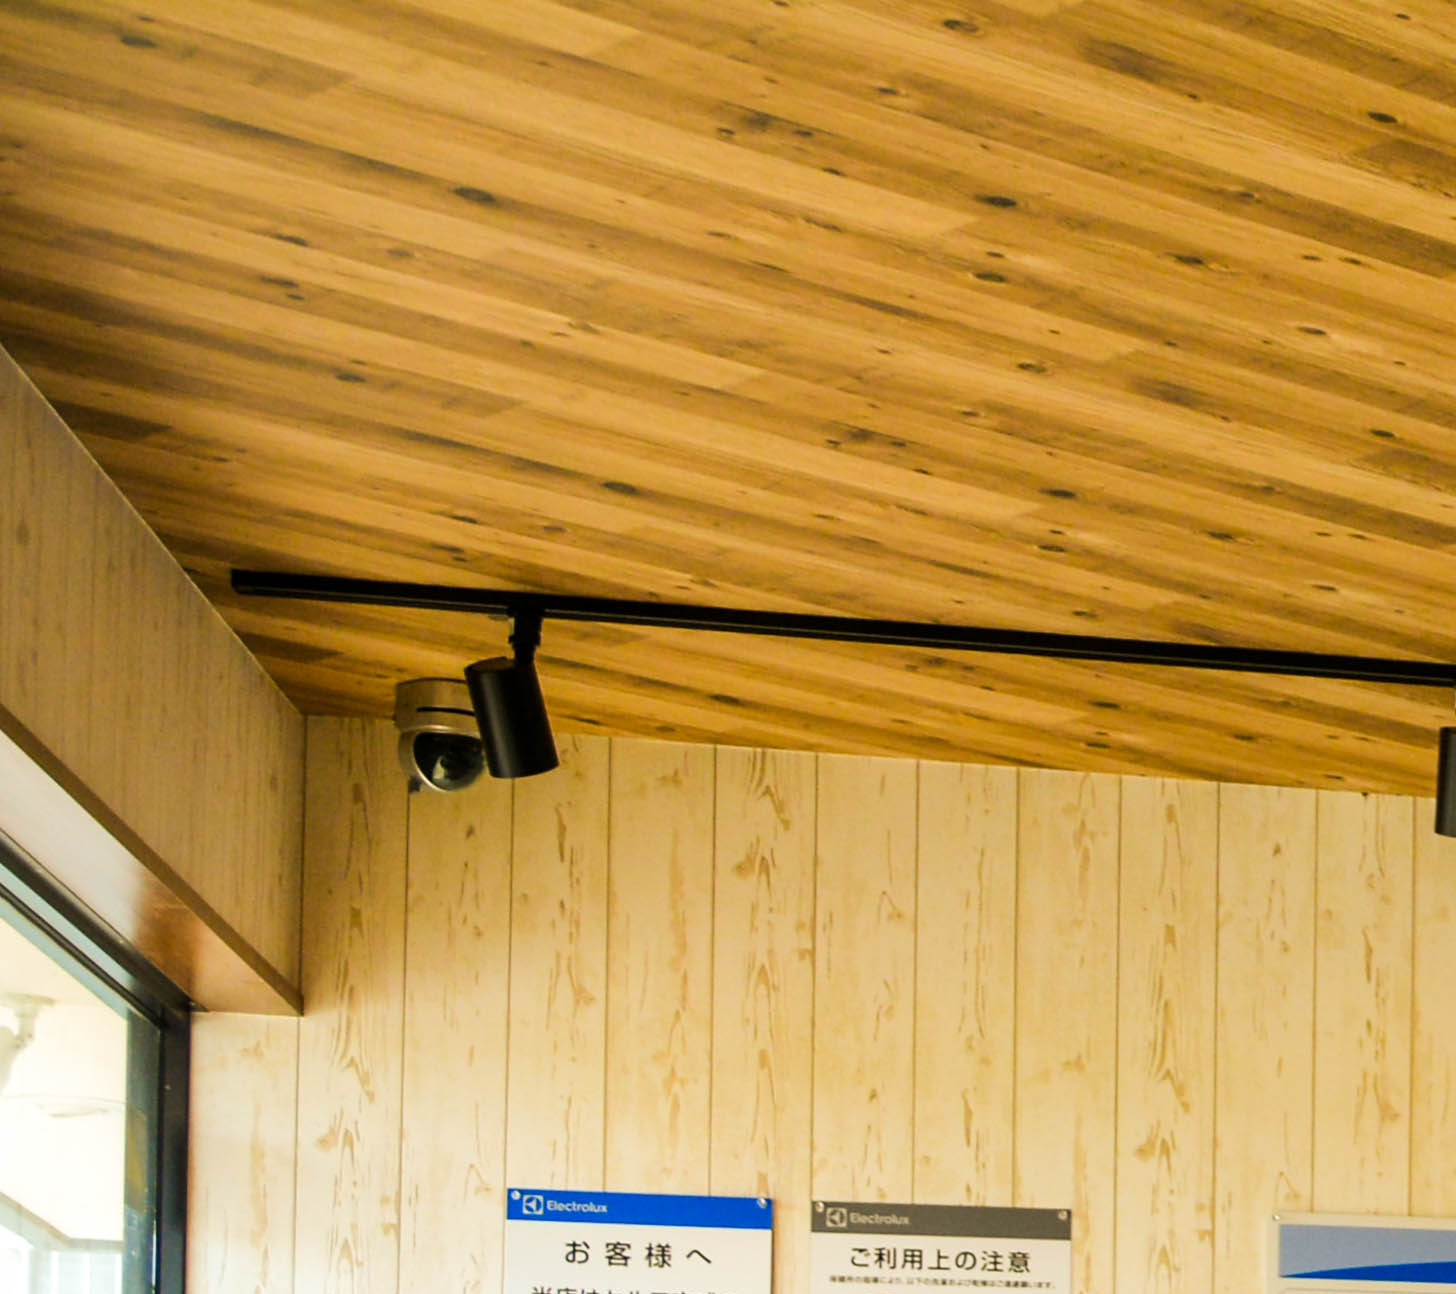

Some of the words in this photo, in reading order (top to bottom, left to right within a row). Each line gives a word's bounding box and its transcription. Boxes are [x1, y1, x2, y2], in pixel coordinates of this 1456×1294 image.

[546, 1199, 608, 1213] Electrolux
[850, 1212, 910, 1225] Electrolux
[564, 1240, 712, 1268] お客様へ
[850, 1247, 1031, 1273] ご利用上の注意
